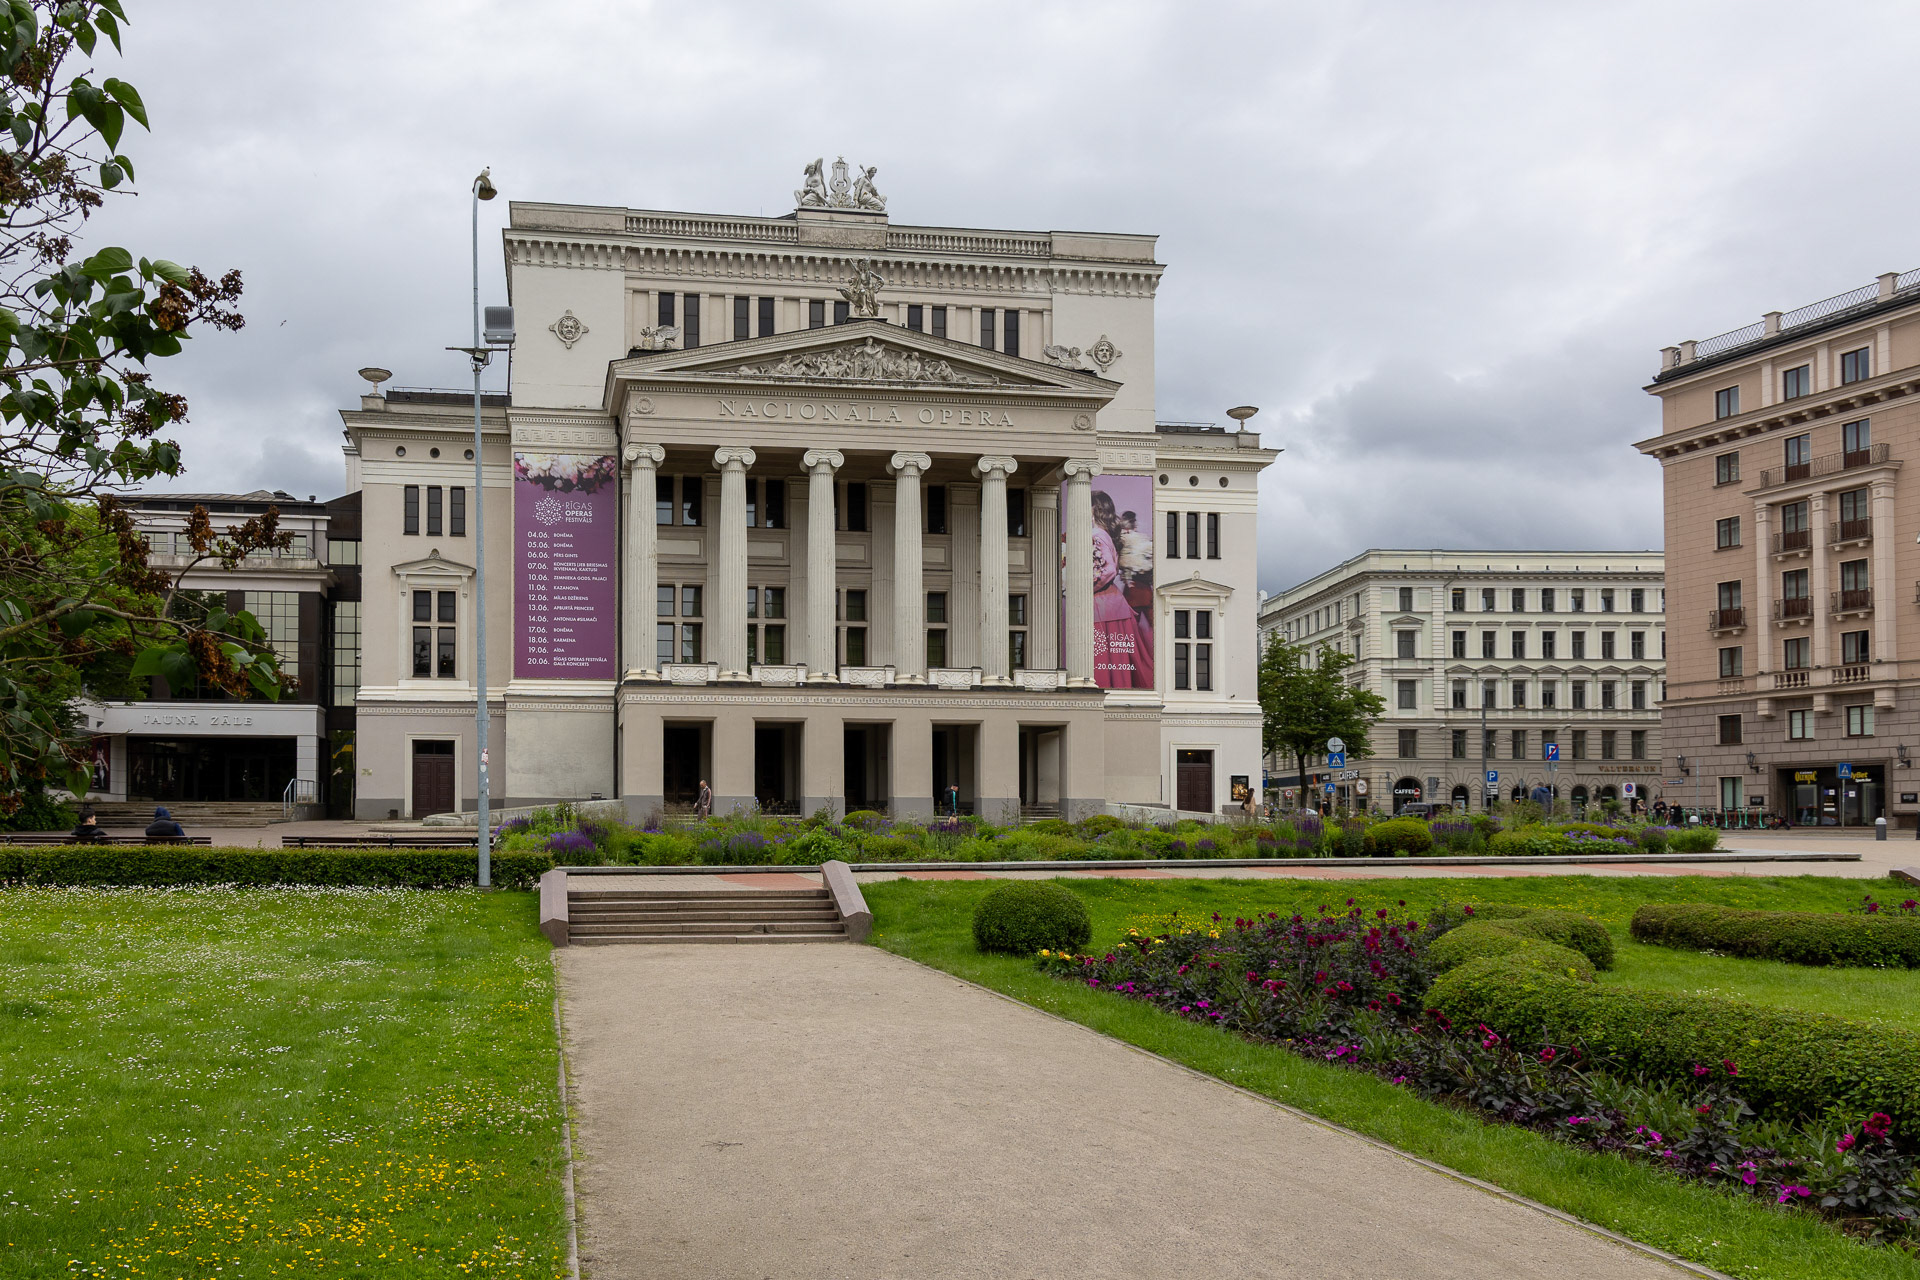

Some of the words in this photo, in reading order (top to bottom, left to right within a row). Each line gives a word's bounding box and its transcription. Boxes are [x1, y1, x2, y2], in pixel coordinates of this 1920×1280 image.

[719, 399, 902, 424] NACIONĀLĀ
[918, 406, 1014, 427] OPERA
[565, 501, 592, 510] RĪGAS
[528, 541, 550, 549] 05.06.
[528, 551, 550, 559] 06.06.
[528, 562, 549, 570] 07.06.
[528, 615, 549, 623] 14.06.
[528, 626, 548, 634] 17.06.
[528, 636, 550, 644] 18.06.
[1110, 632, 1135, 641] RĪGAS
[528, 646, 549, 654] 19.06.
[527, 657, 550, 665] 20.06.
[143, 714, 198, 726] JAUNĀ
[210, 715, 253, 726] ZĀLE
[1338, 769, 1360, 780] CAFEINE
[1489, 771, 1496, 781] P
